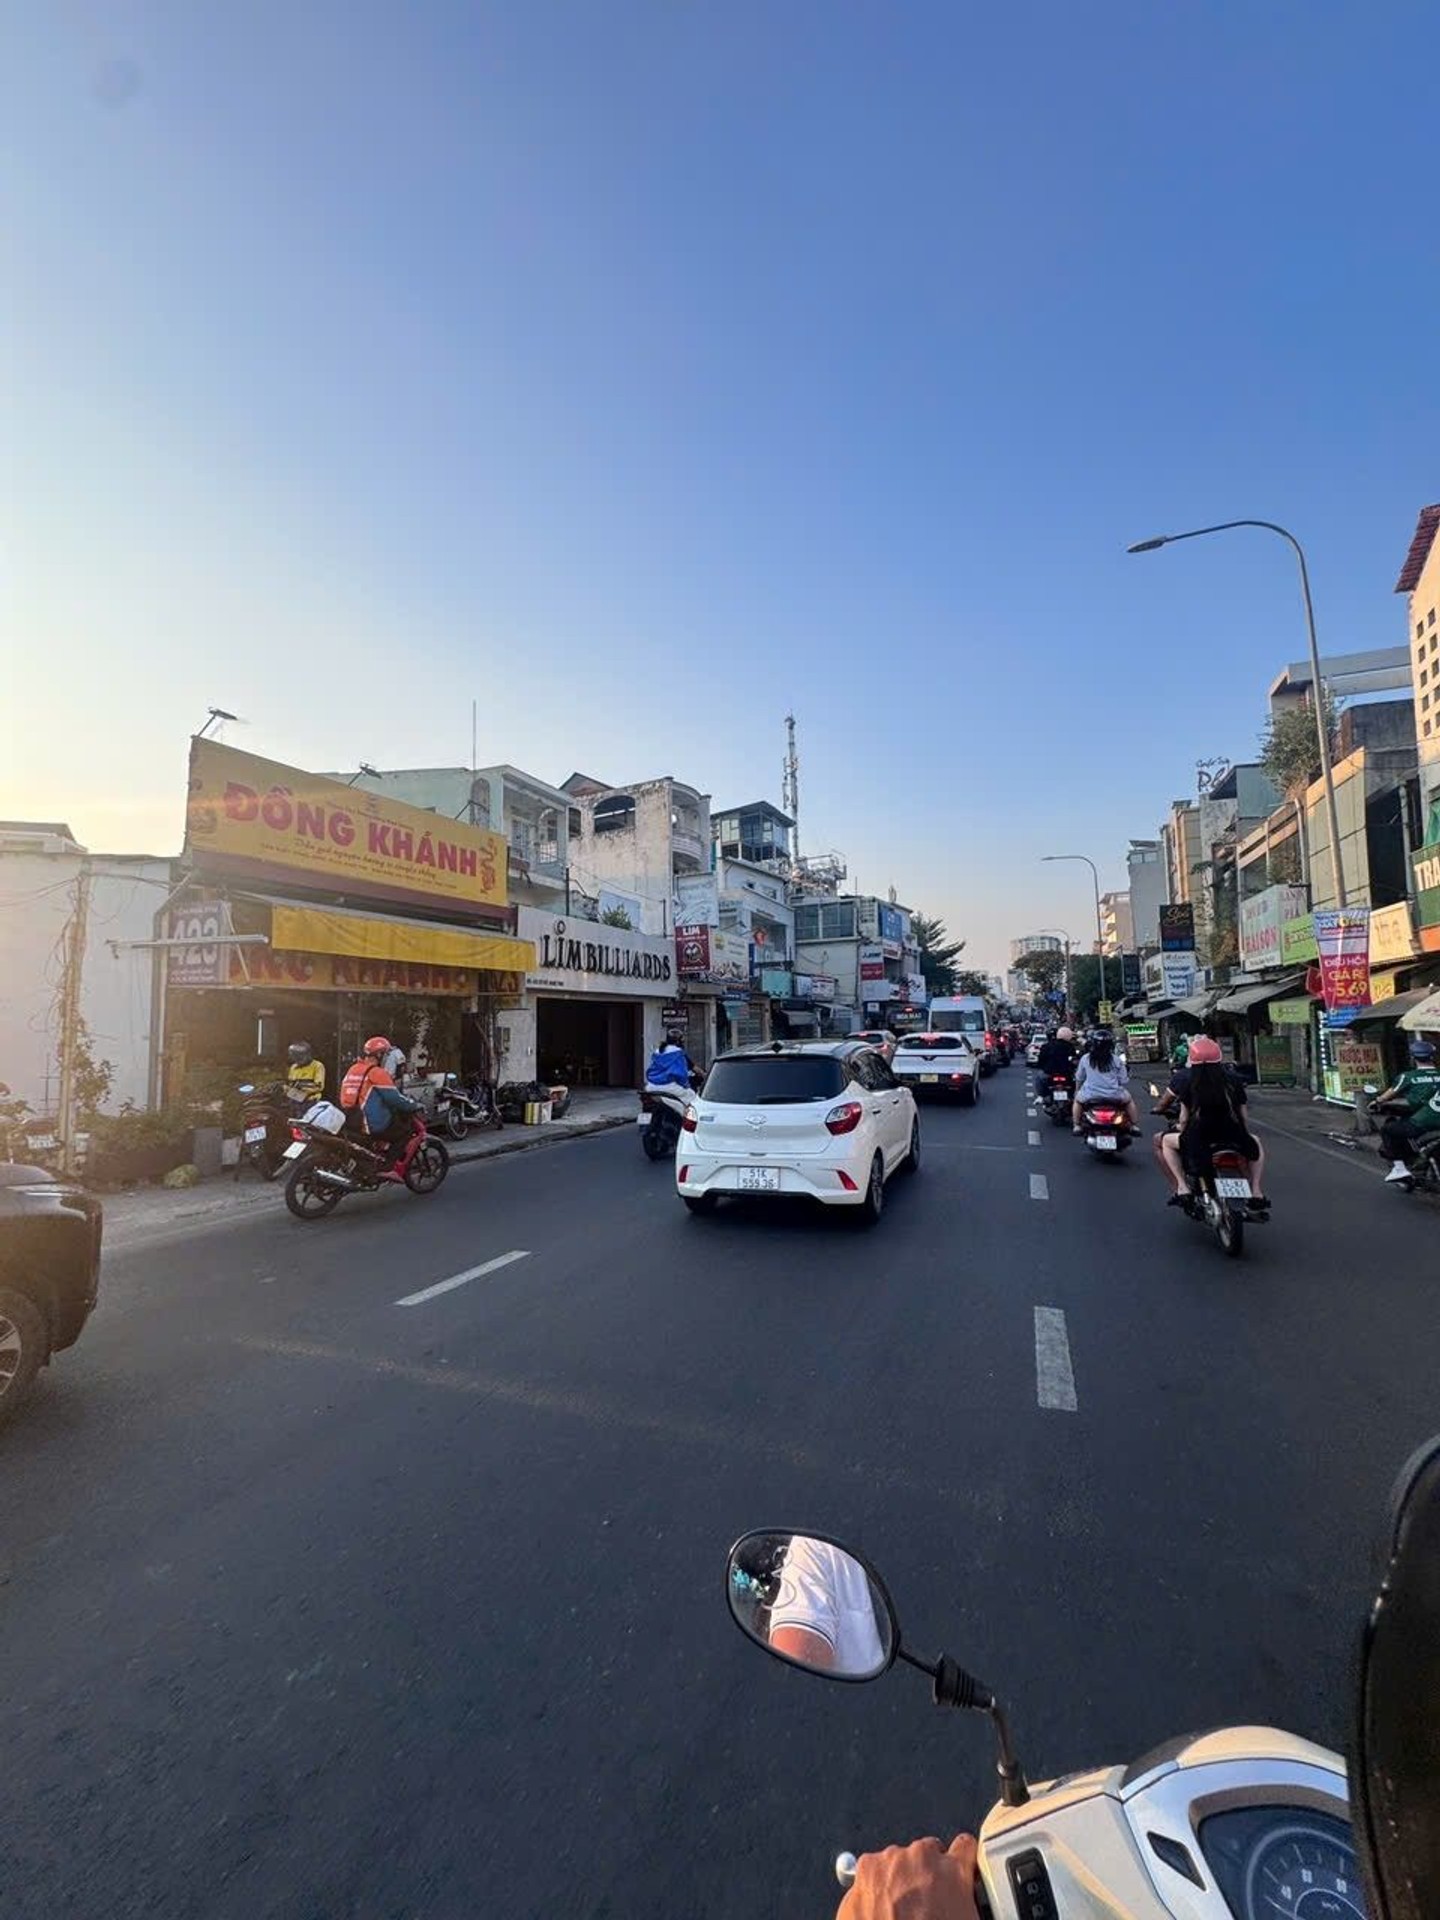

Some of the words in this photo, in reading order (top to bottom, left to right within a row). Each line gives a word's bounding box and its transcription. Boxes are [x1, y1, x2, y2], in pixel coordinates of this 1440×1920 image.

[223, 781, 355, 847] ĐỒNG
[368, 821, 477, 877] KHÁNH
[682, 925, 700, 936] LIM
[750, 1168, 767, 1178] 51K
